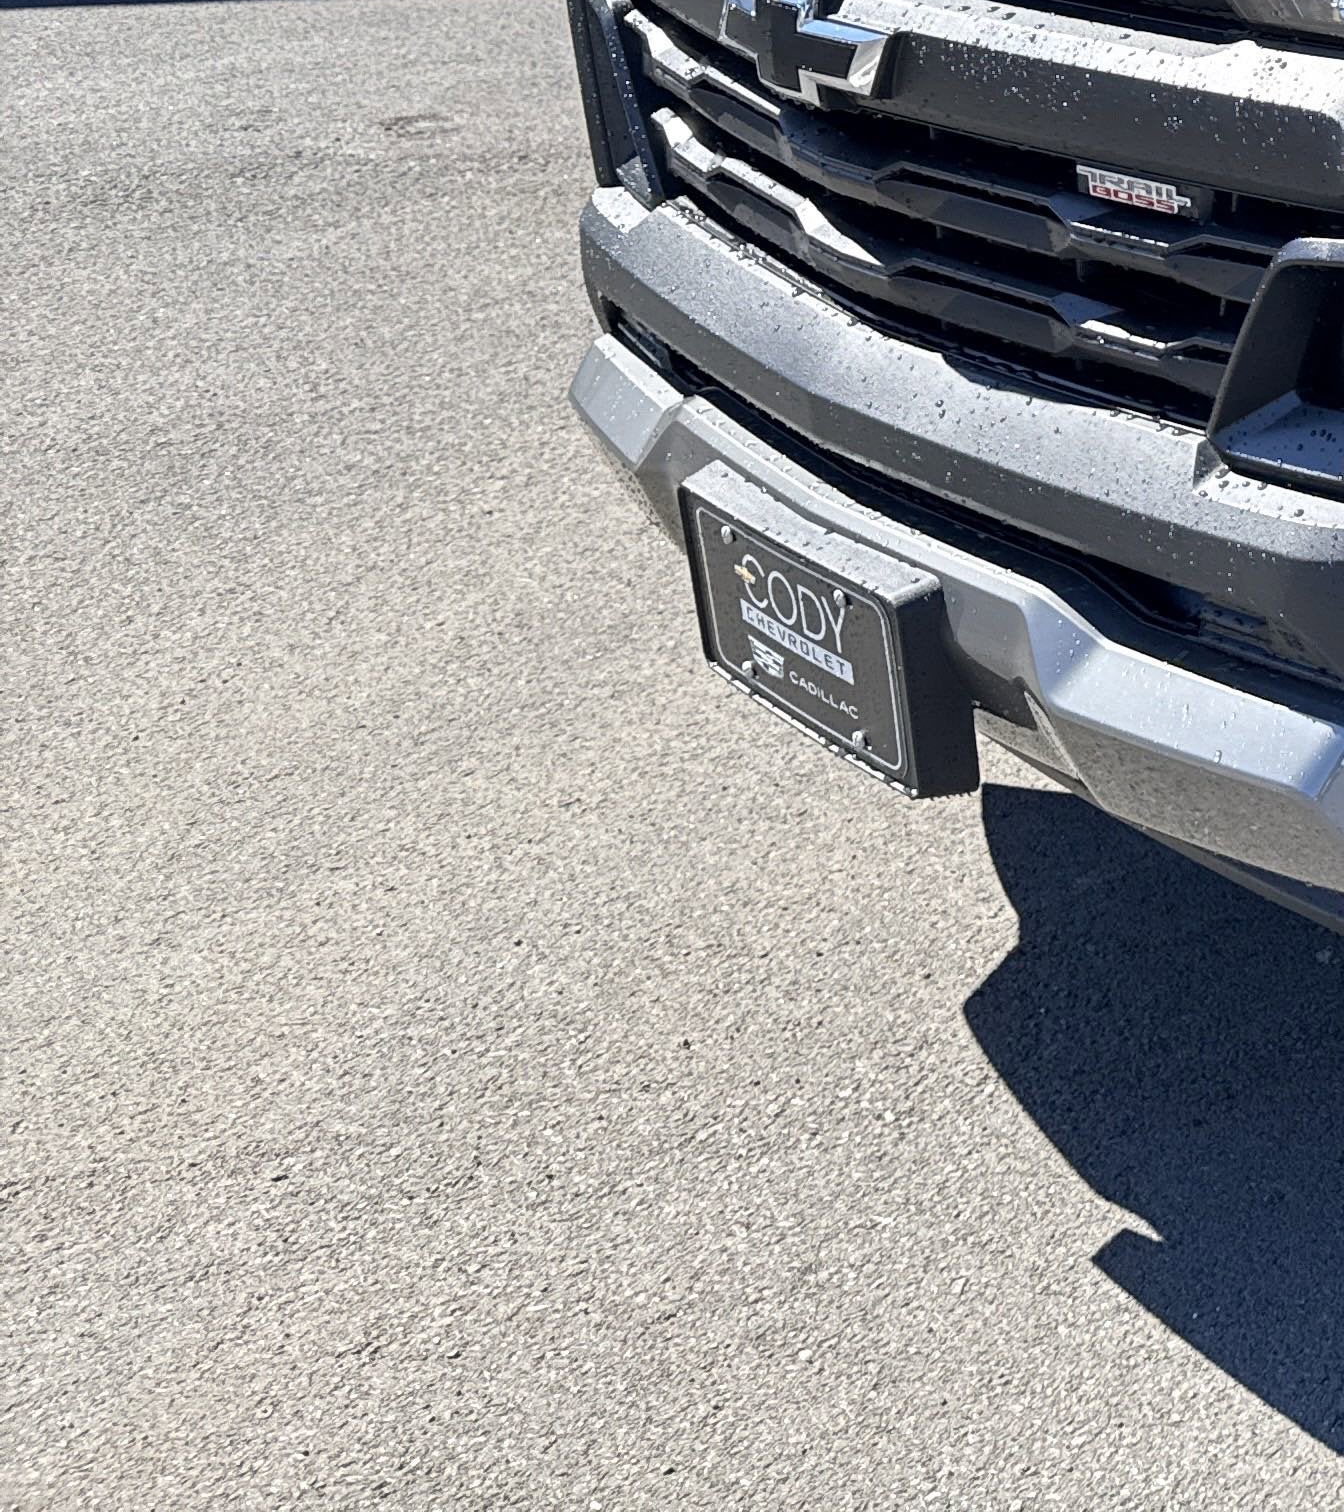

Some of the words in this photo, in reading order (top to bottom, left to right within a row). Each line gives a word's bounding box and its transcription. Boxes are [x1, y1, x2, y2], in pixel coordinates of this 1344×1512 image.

[1076, 164, 1192, 207] TRAIL
[1091, 184, 1179, 215] BOSS
[741, 553, 846, 654] CODY
[745, 606, 847, 678] CHEVROLET
[788, 670, 859, 720] CADILLAC
